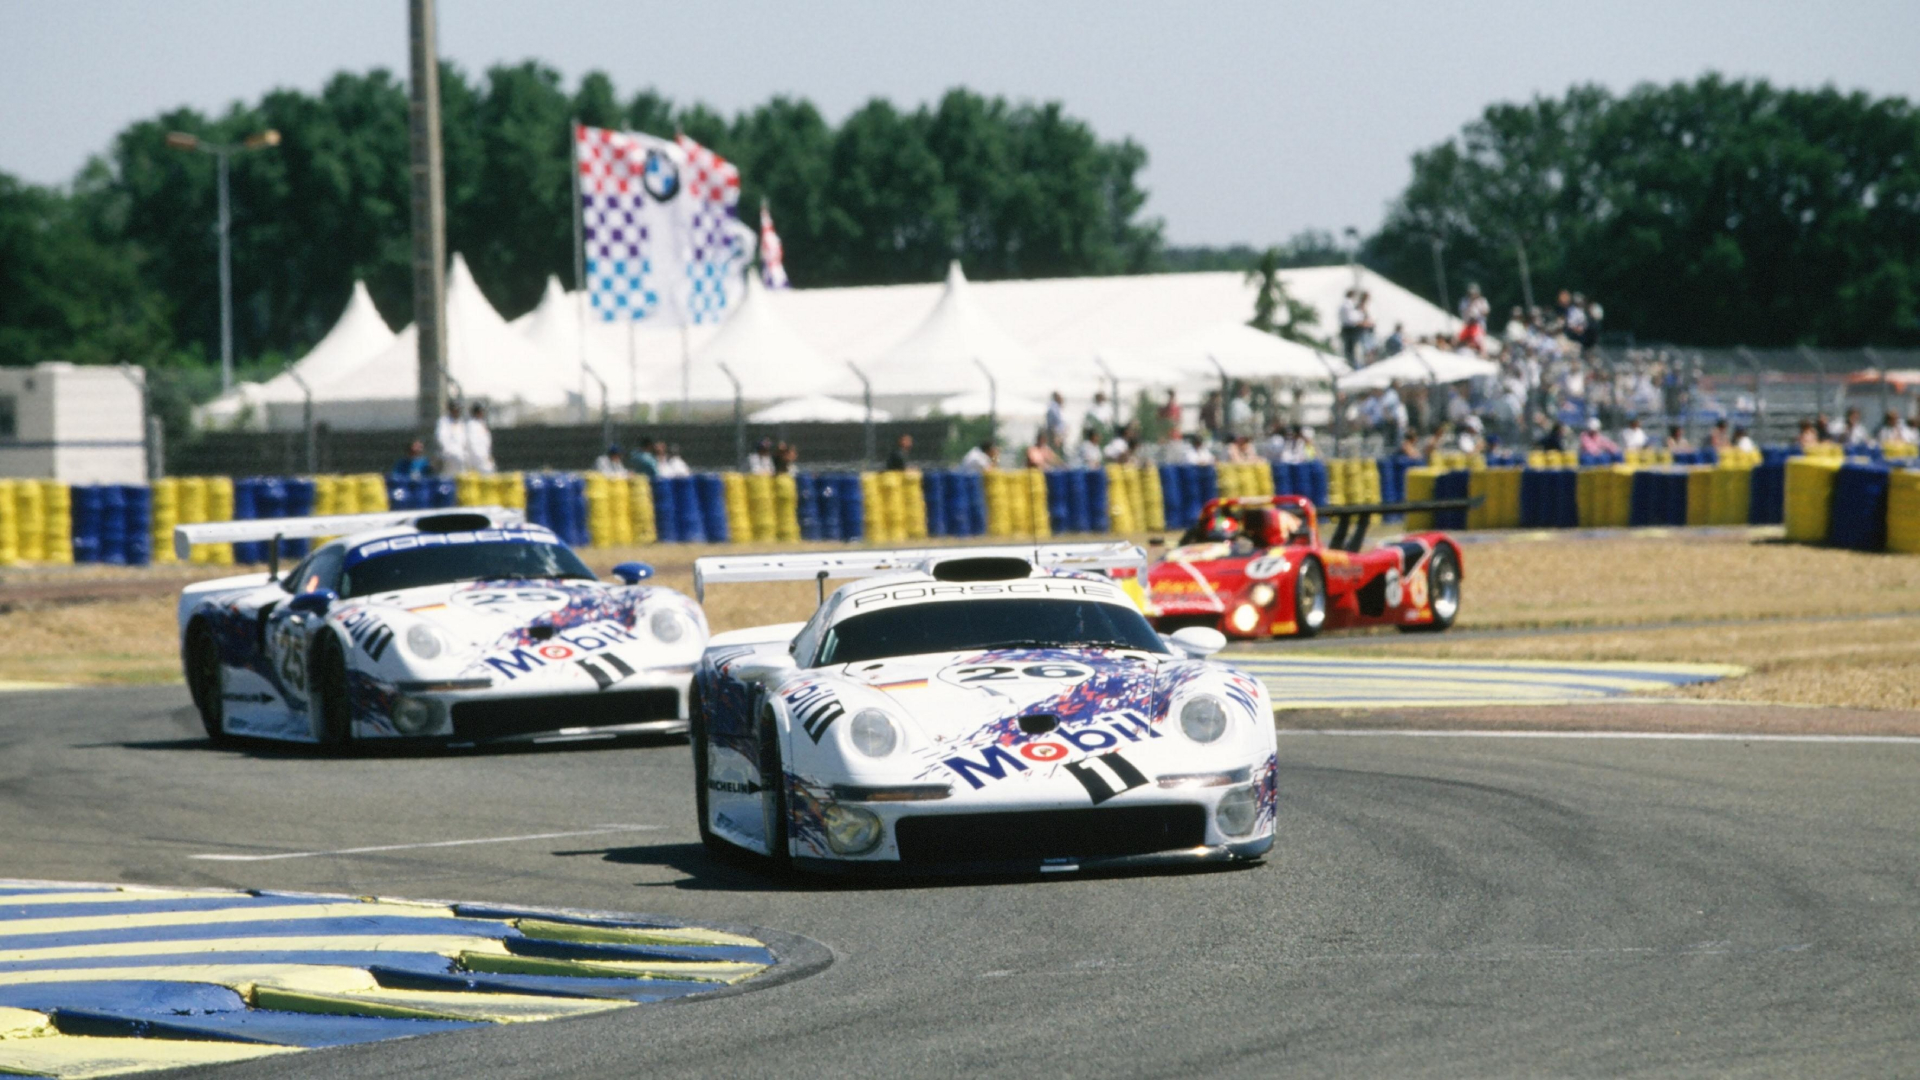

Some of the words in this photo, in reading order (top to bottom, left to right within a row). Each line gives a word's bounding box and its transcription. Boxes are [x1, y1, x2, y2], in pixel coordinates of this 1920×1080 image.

[360, 531, 560, 558] PORSCHE
[854, 583, 1116, 609] PORSCHE
[484, 624, 638, 680] Mobil
[956, 664, 1086, 683] 26
[943, 711, 1164, 790] Mobil
